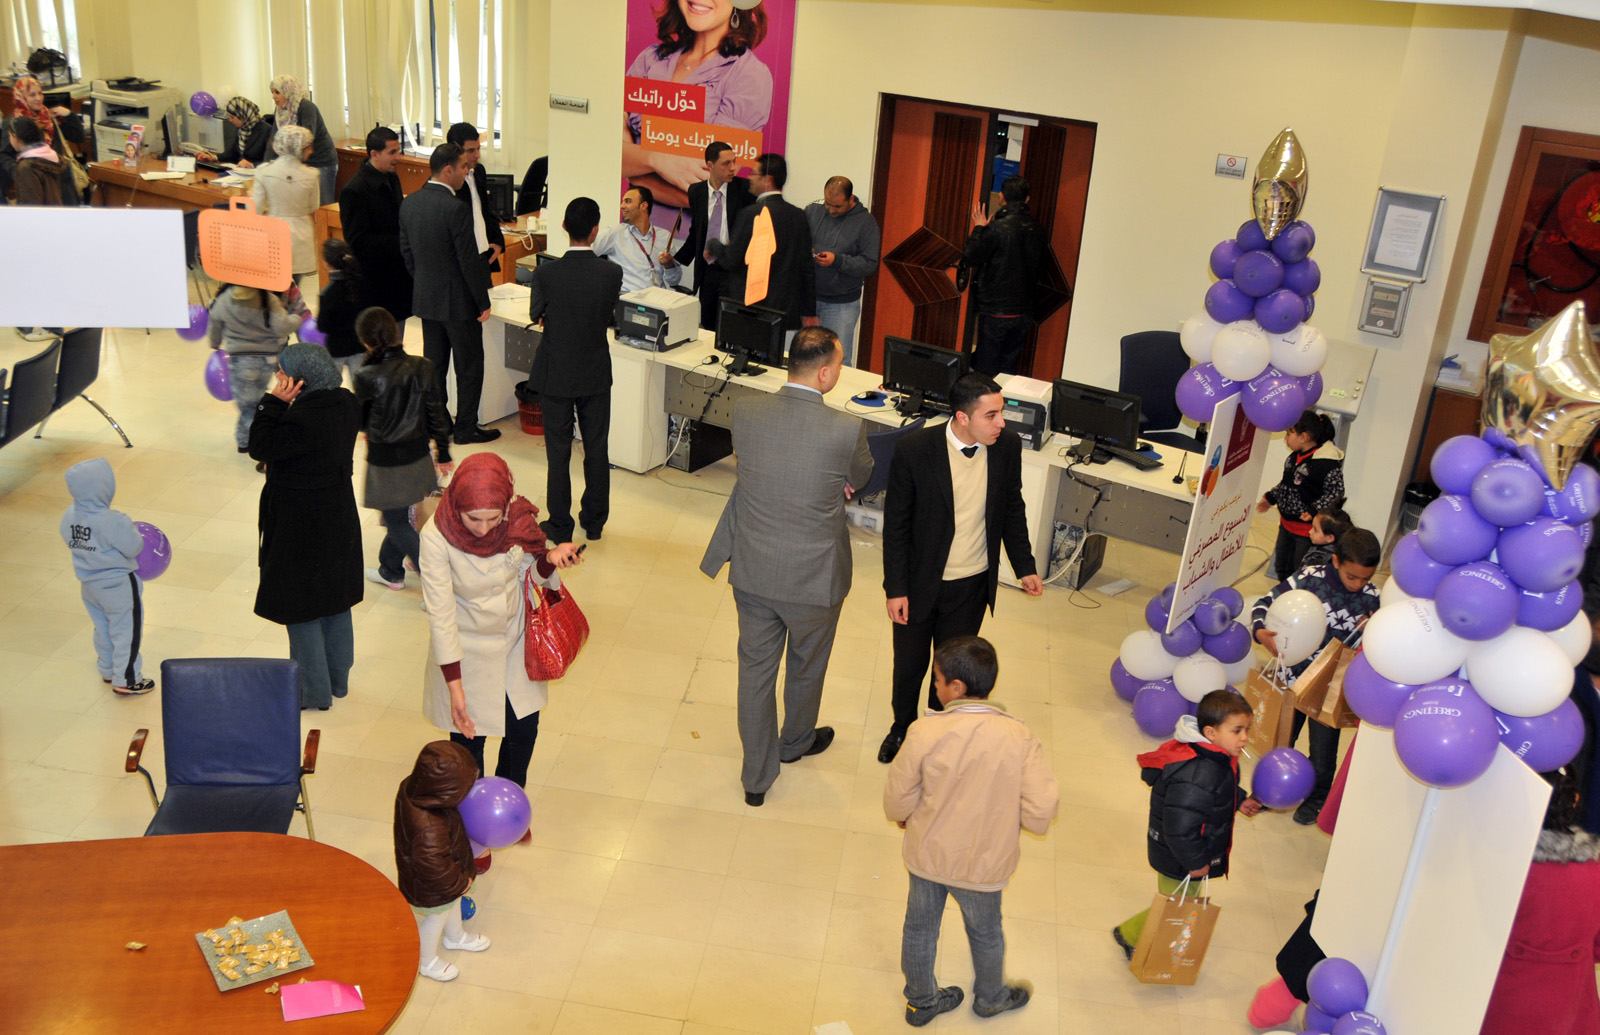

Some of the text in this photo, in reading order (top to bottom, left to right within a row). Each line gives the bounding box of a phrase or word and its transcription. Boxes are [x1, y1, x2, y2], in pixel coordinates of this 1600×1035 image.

[628, 87, 697, 112] حوّل راتبك
[645, 120, 758, 160] وإرب اتبك يومياً
[1259, 383, 1293, 405] GREETINGS
[1459, 570, 1506, 590] GREETINGS
[1403, 706, 1462, 721] GREETINGS
